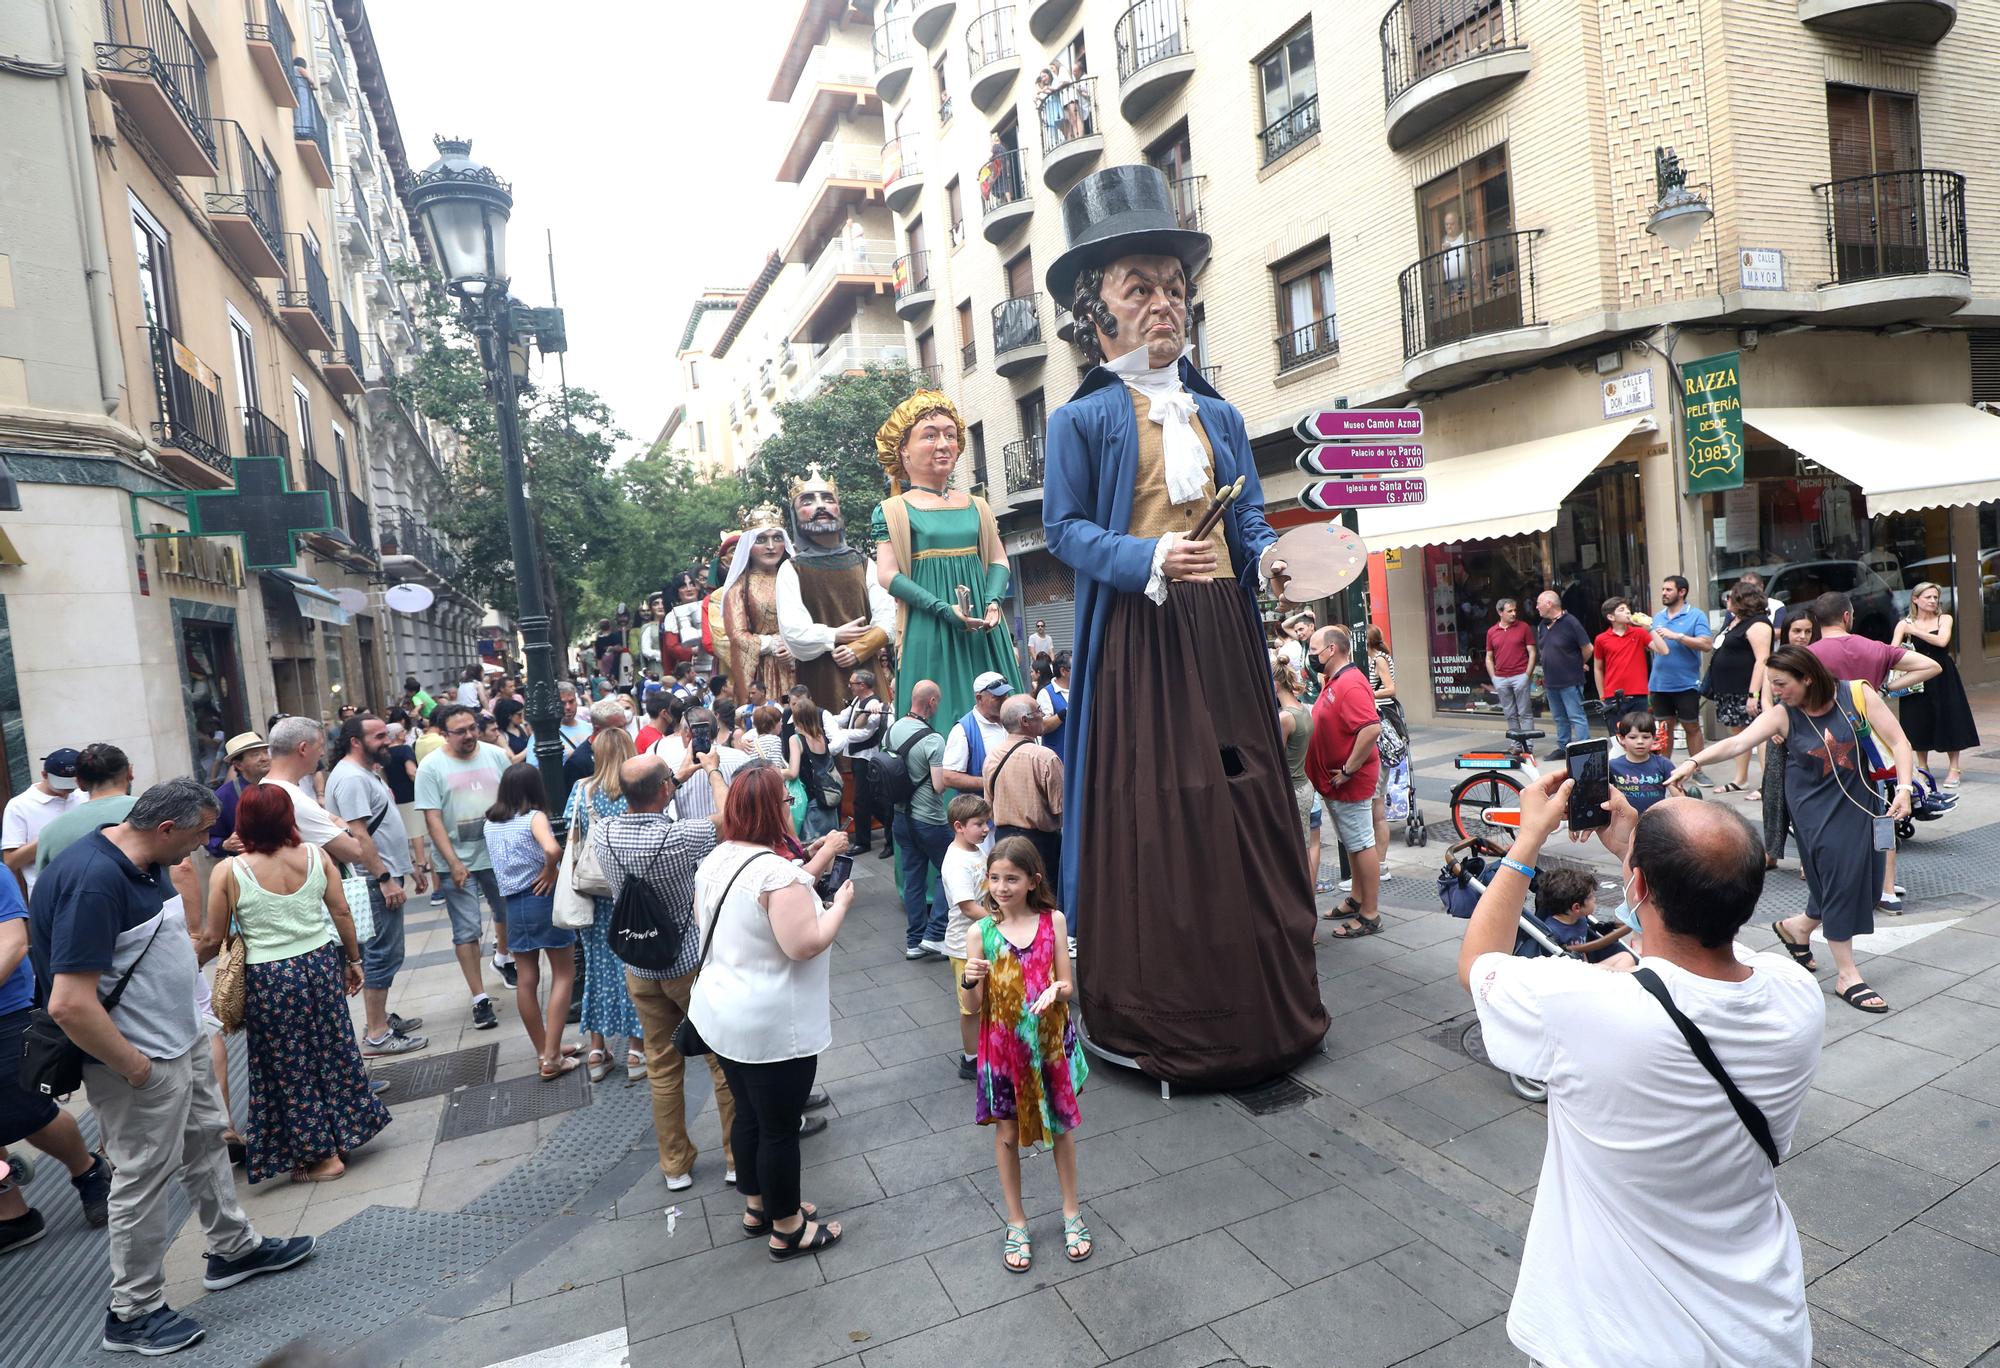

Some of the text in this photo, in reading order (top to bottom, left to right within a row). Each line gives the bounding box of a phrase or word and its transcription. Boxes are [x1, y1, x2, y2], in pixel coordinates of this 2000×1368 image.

[1758, 254, 1775, 263] CALLE
[1747, 271, 1777, 283] MAYOR
[1622, 375, 1642, 388] CALLE
[1685, 368, 1738, 396] RAZZA
[1610, 397, 1623, 409] DON
[1625, 391, 1641, 405] JAIME
[1686, 395, 1740, 418] PELETERÍA
[1343, 418, 1420, 429] Museo Camón Aznar
[1700, 418, 1727, 432] DESDE
[1351, 446, 1422, 457] Palacio de los Pardo
[1696, 444, 1731, 464] 1985
[1346, 484, 1368, 493] Iglesia
[1380, 481, 1402, 491] Santa
[1404, 480, 1423, 490] Cruz
[1020, 534, 1029, 547] EL
[1433, 656, 1441, 664] LA
[1433, 666, 1467, 674] LA VESPITA
[1434, 676, 1454, 684] FYORD
[1436, 686, 1471, 694] EL CABALLO
